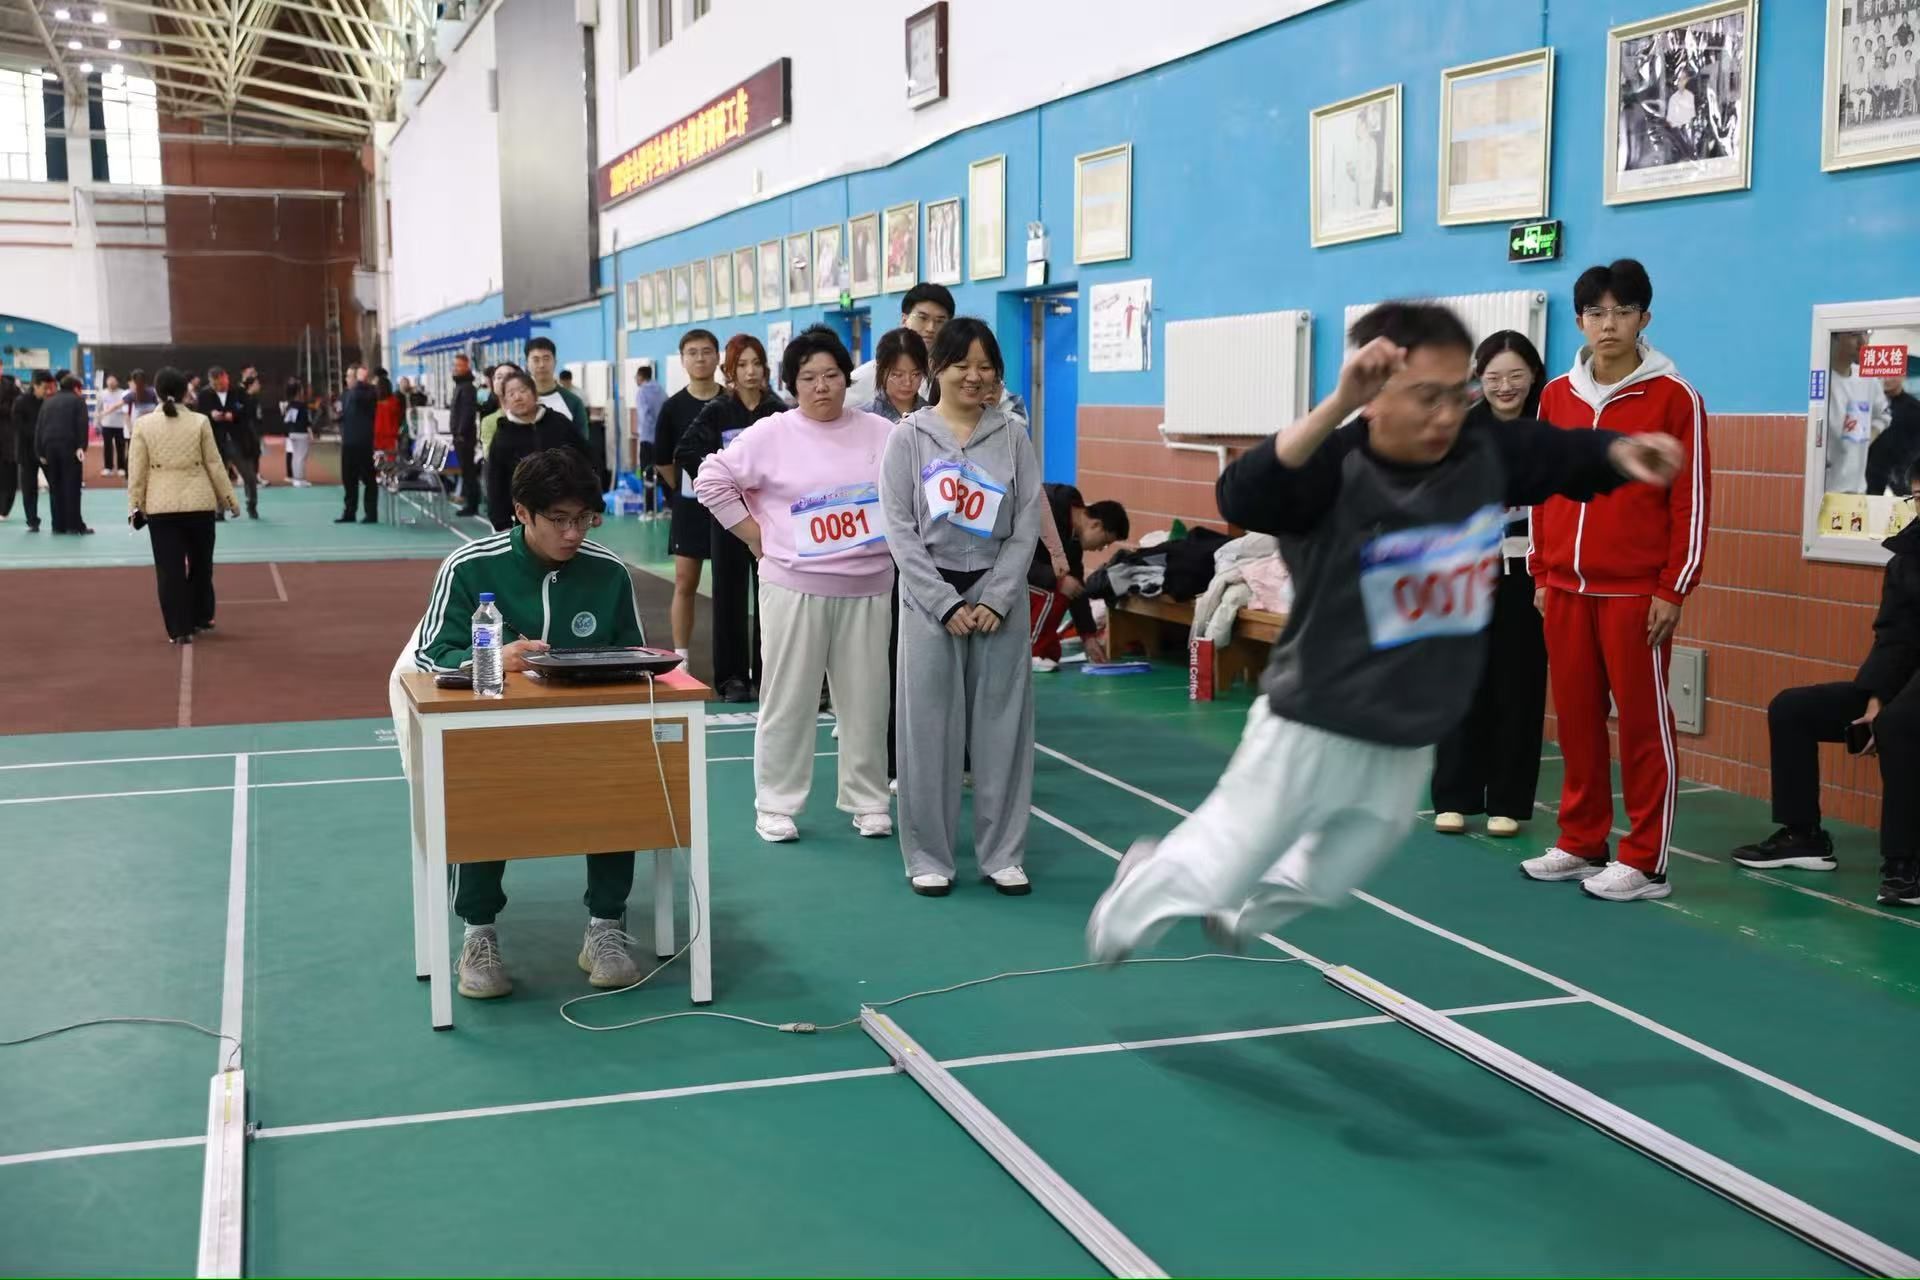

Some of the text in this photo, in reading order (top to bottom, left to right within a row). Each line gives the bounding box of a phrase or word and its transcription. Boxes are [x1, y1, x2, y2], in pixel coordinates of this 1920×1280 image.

[1864, 348, 1903, 366] 消火栓
[810, 508, 870, 544] 0081
[1190, 640, 1199, 699] Cotti Coffee
